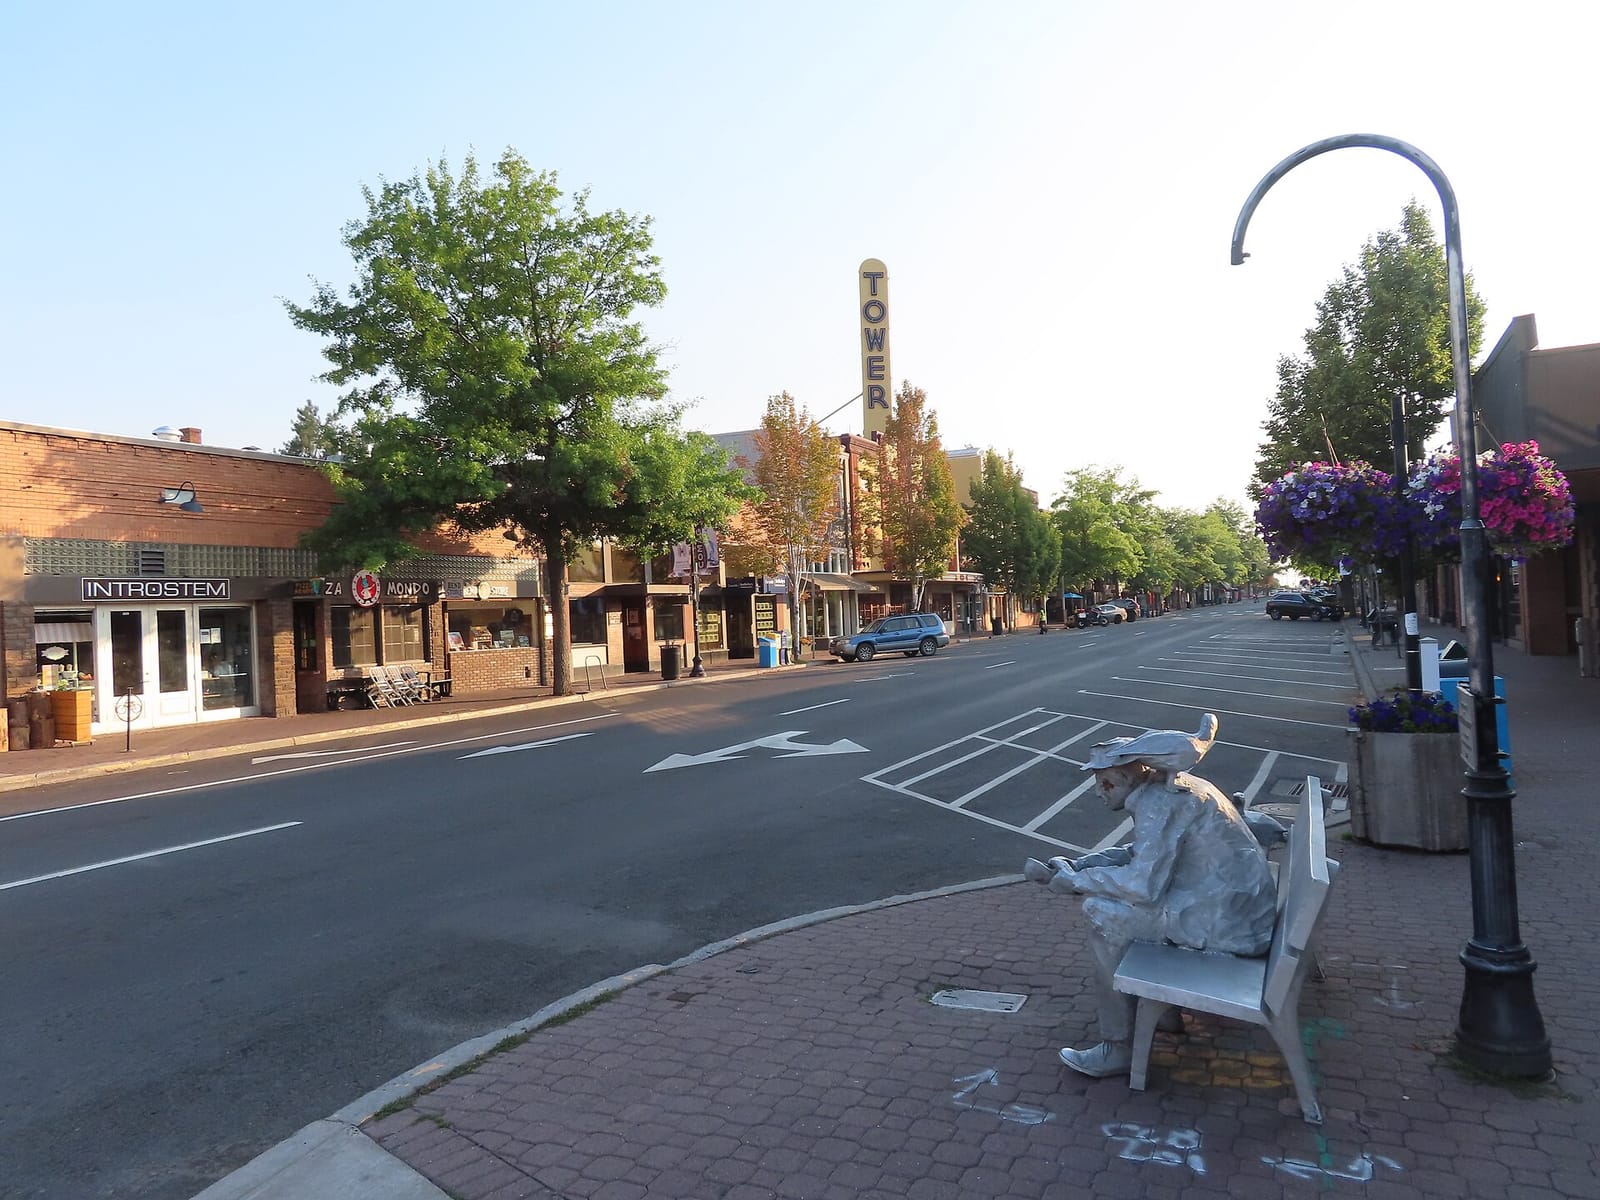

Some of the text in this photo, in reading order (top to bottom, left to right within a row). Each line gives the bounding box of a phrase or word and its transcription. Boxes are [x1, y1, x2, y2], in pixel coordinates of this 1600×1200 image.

[863, 271, 889, 409] TOWER
[88, 581, 226, 597] INTROSTEM
[387, 582, 429, 596] MONDO
